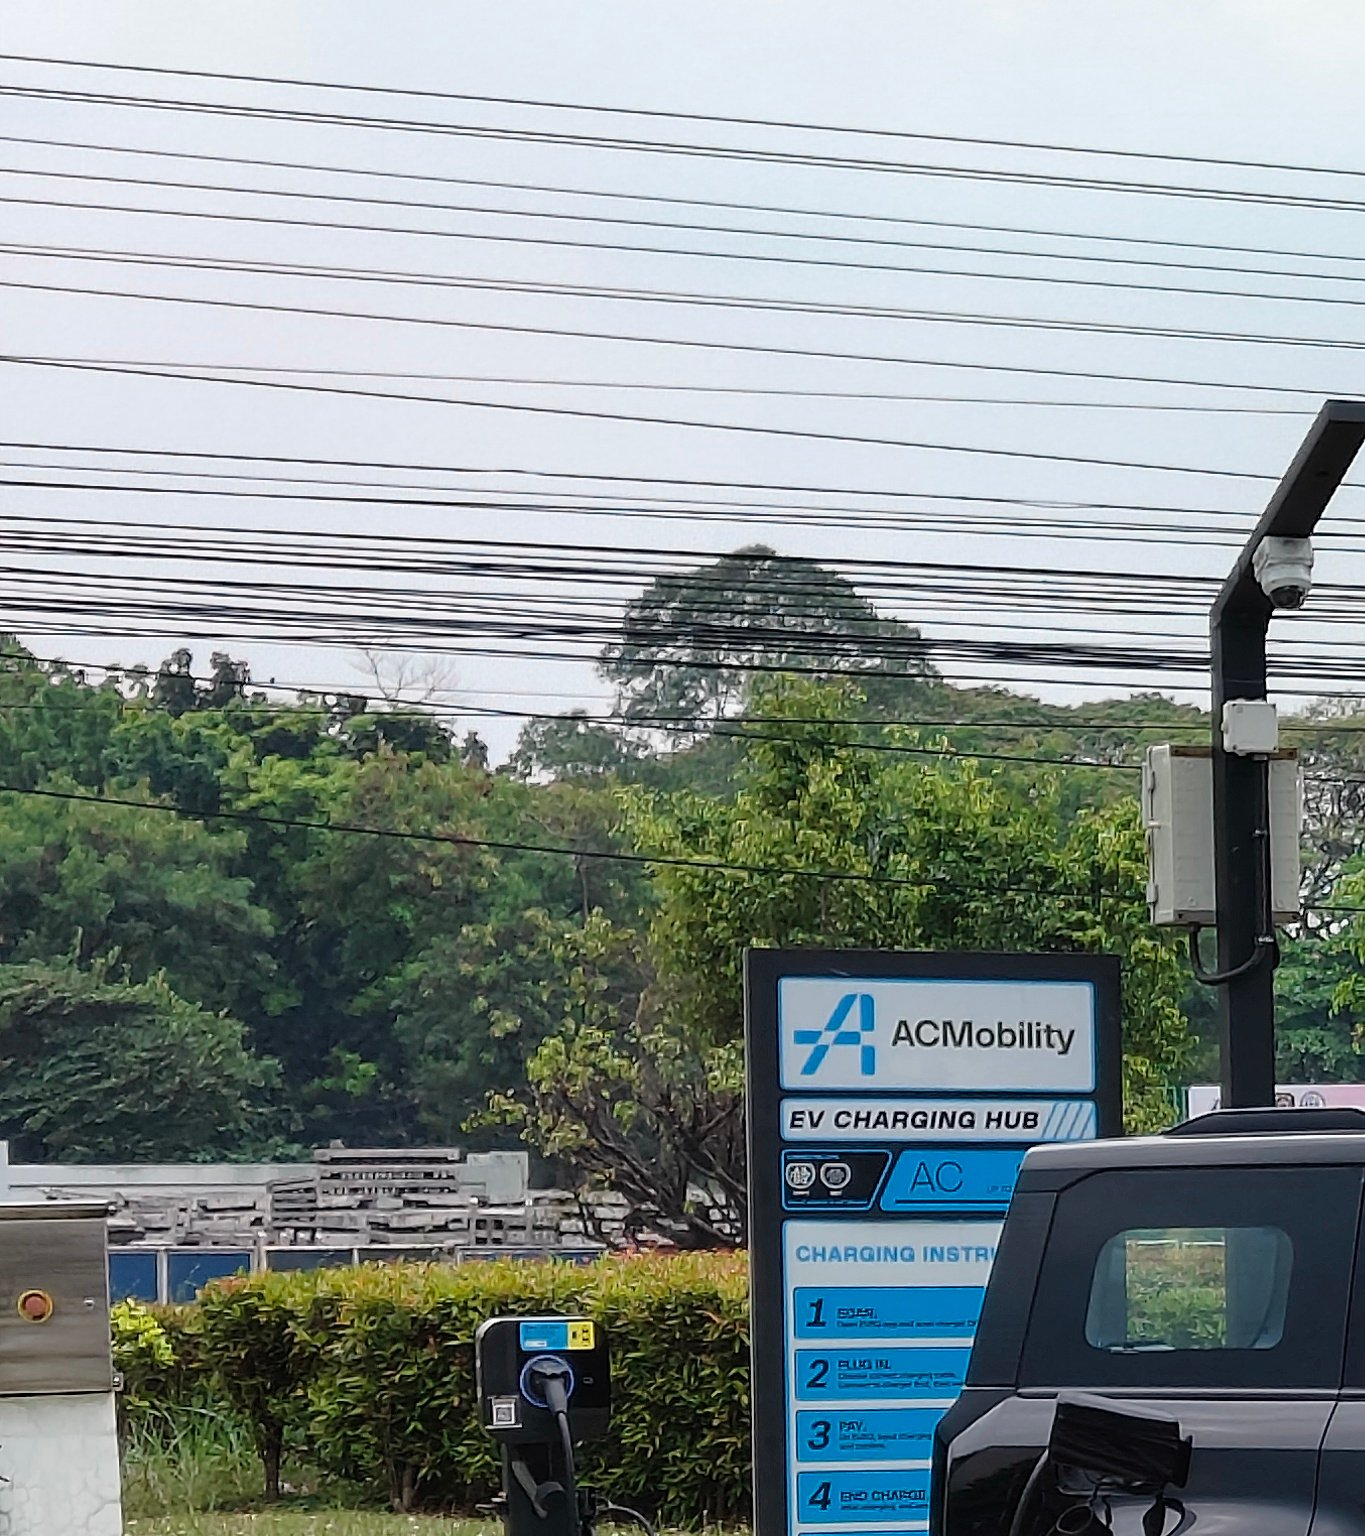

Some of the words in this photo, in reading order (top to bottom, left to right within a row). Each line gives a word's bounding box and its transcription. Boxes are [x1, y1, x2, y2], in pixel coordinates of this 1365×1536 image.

[892, 1019, 1075, 1055] ACMobility
[789, 1110, 824, 1130] EV
[833, 1110, 976, 1130] CHARGING
[984, 1110, 1039, 1130] HUB
[910, 1161, 963, 1193] AC
[795, 1245, 915, 1263] CHARGING
[806, 1298, 827, 1327] 1
[806, 1359, 829, 1388] 2
[808, 1421, 831, 1449] 3
[808, 1482, 831, 1511] 4
